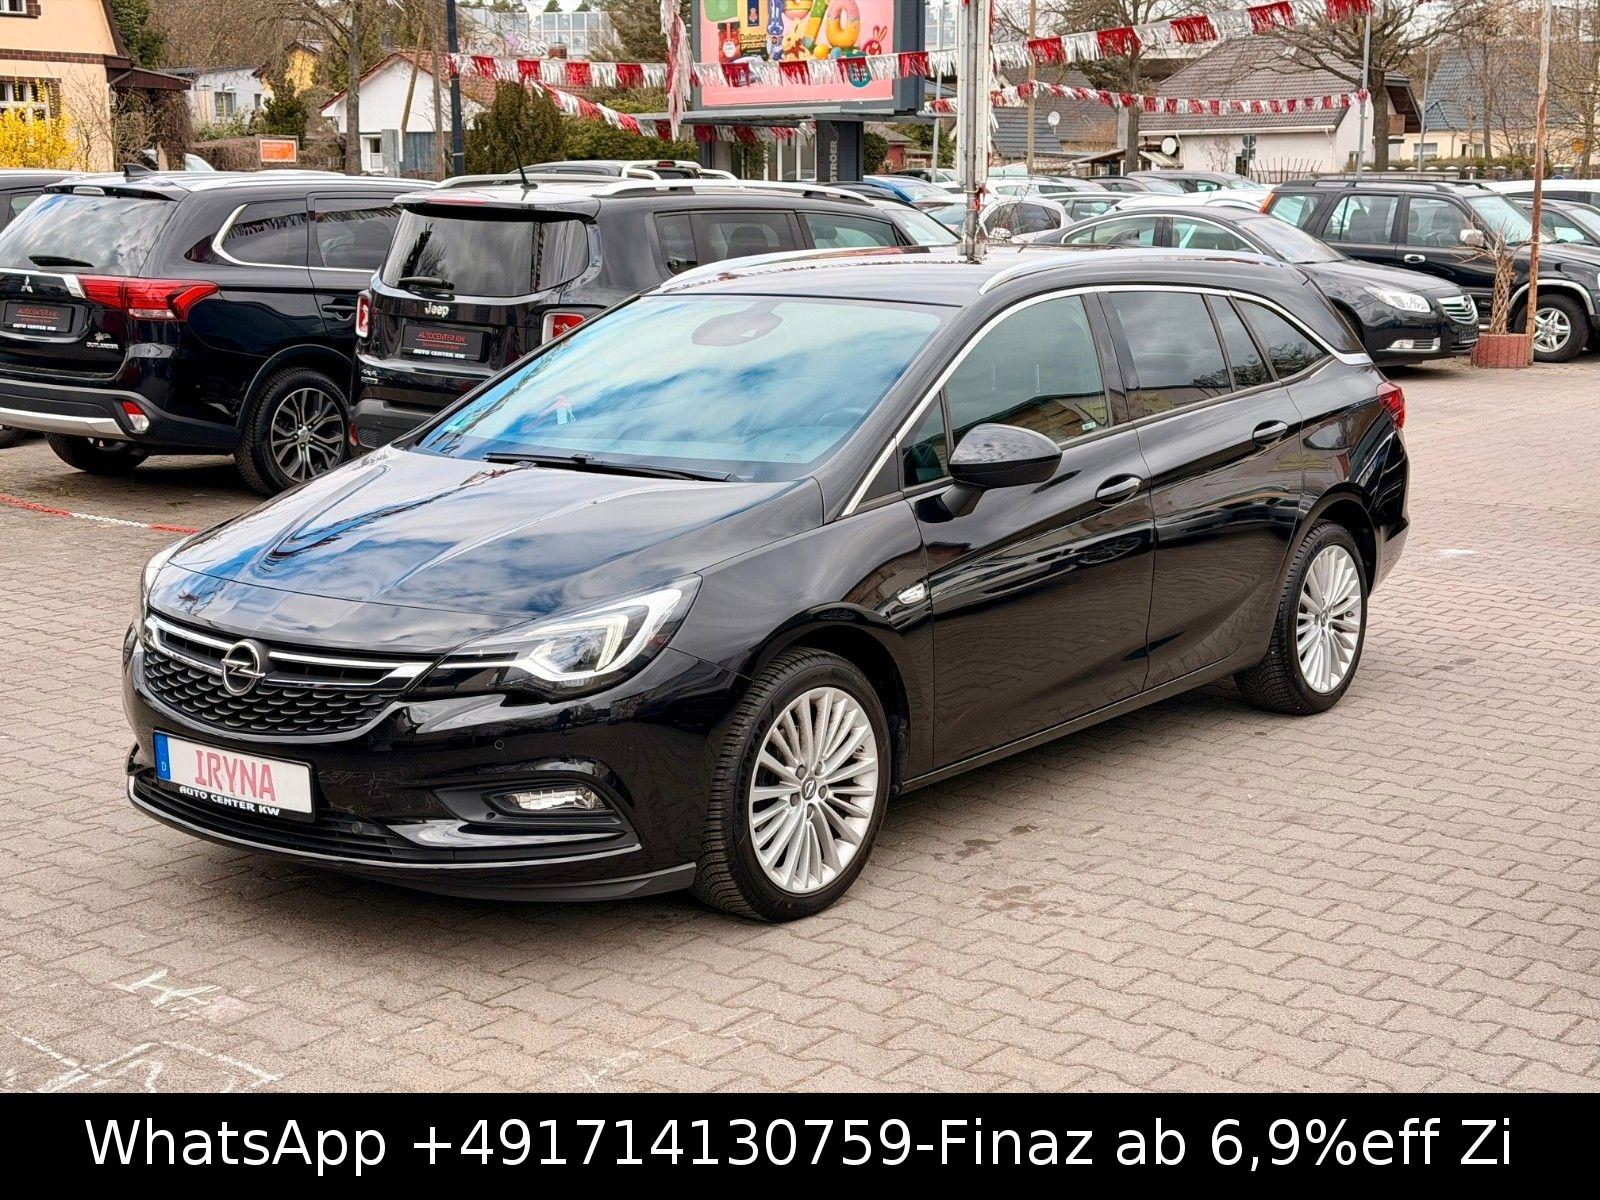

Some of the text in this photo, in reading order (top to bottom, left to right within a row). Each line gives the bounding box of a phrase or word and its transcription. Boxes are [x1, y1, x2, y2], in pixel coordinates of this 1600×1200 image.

[740, 33, 767, 42] Dallmayr
[424, 302, 450, 318] Jeep
[431, 350, 454, 358] CENTER
[161, 761, 167, 771] D
[194, 749, 276, 801] IRYNA
[179, 785, 280, 816] AUTO CENTER KW
